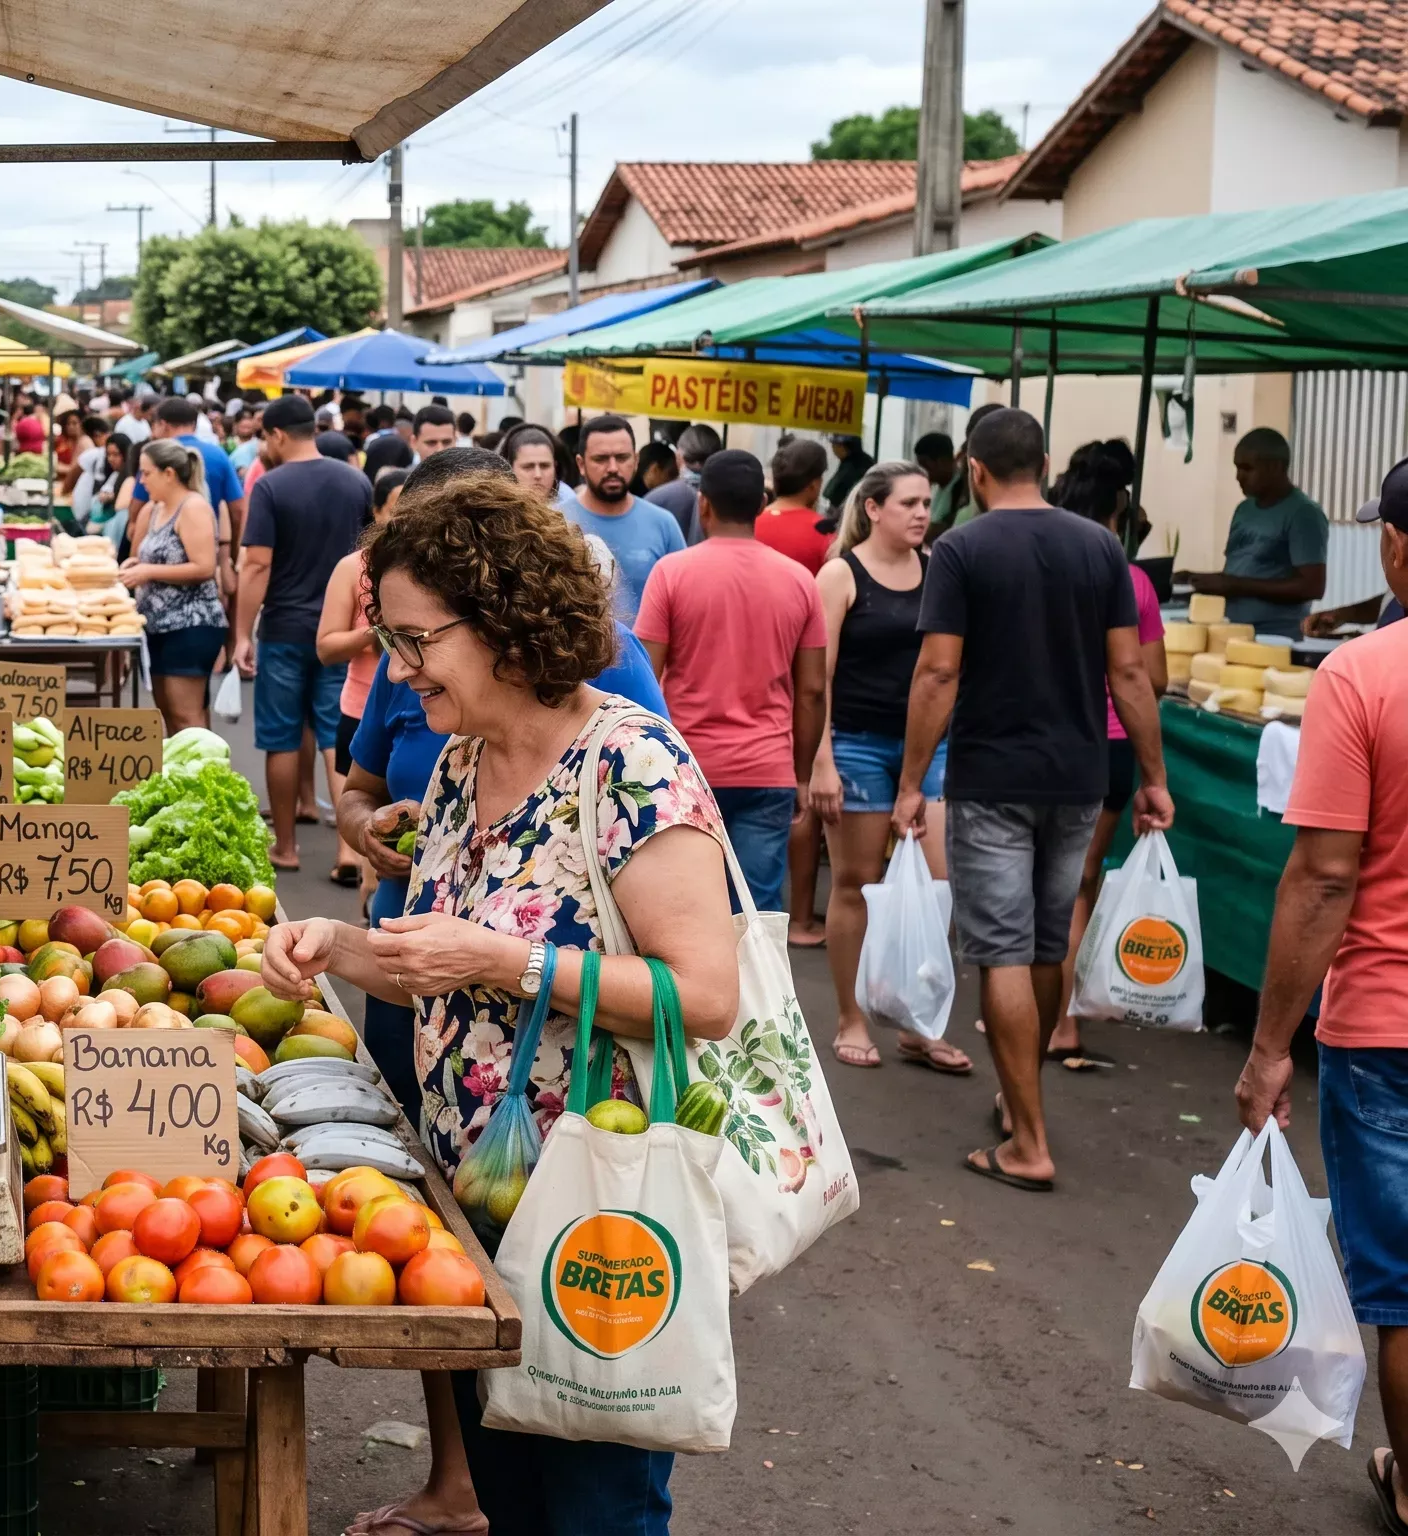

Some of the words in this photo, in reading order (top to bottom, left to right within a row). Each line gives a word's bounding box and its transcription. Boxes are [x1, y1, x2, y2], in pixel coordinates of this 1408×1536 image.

[650, 370, 758, 415] PASTÉIS
[767, 381, 782, 416] E
[67, 755, 93, 781] R$
[35, 853, 113, 902] 7,50
[103, 893, 124, 915] Kg
[69, 1033, 218, 1072] Banana
[71, 1086, 114, 1128] R$
[126, 1078, 222, 1138] 4,00
[203, 1132, 231, 1166] Kg
[559, 1259, 665, 1301] BRETAS
